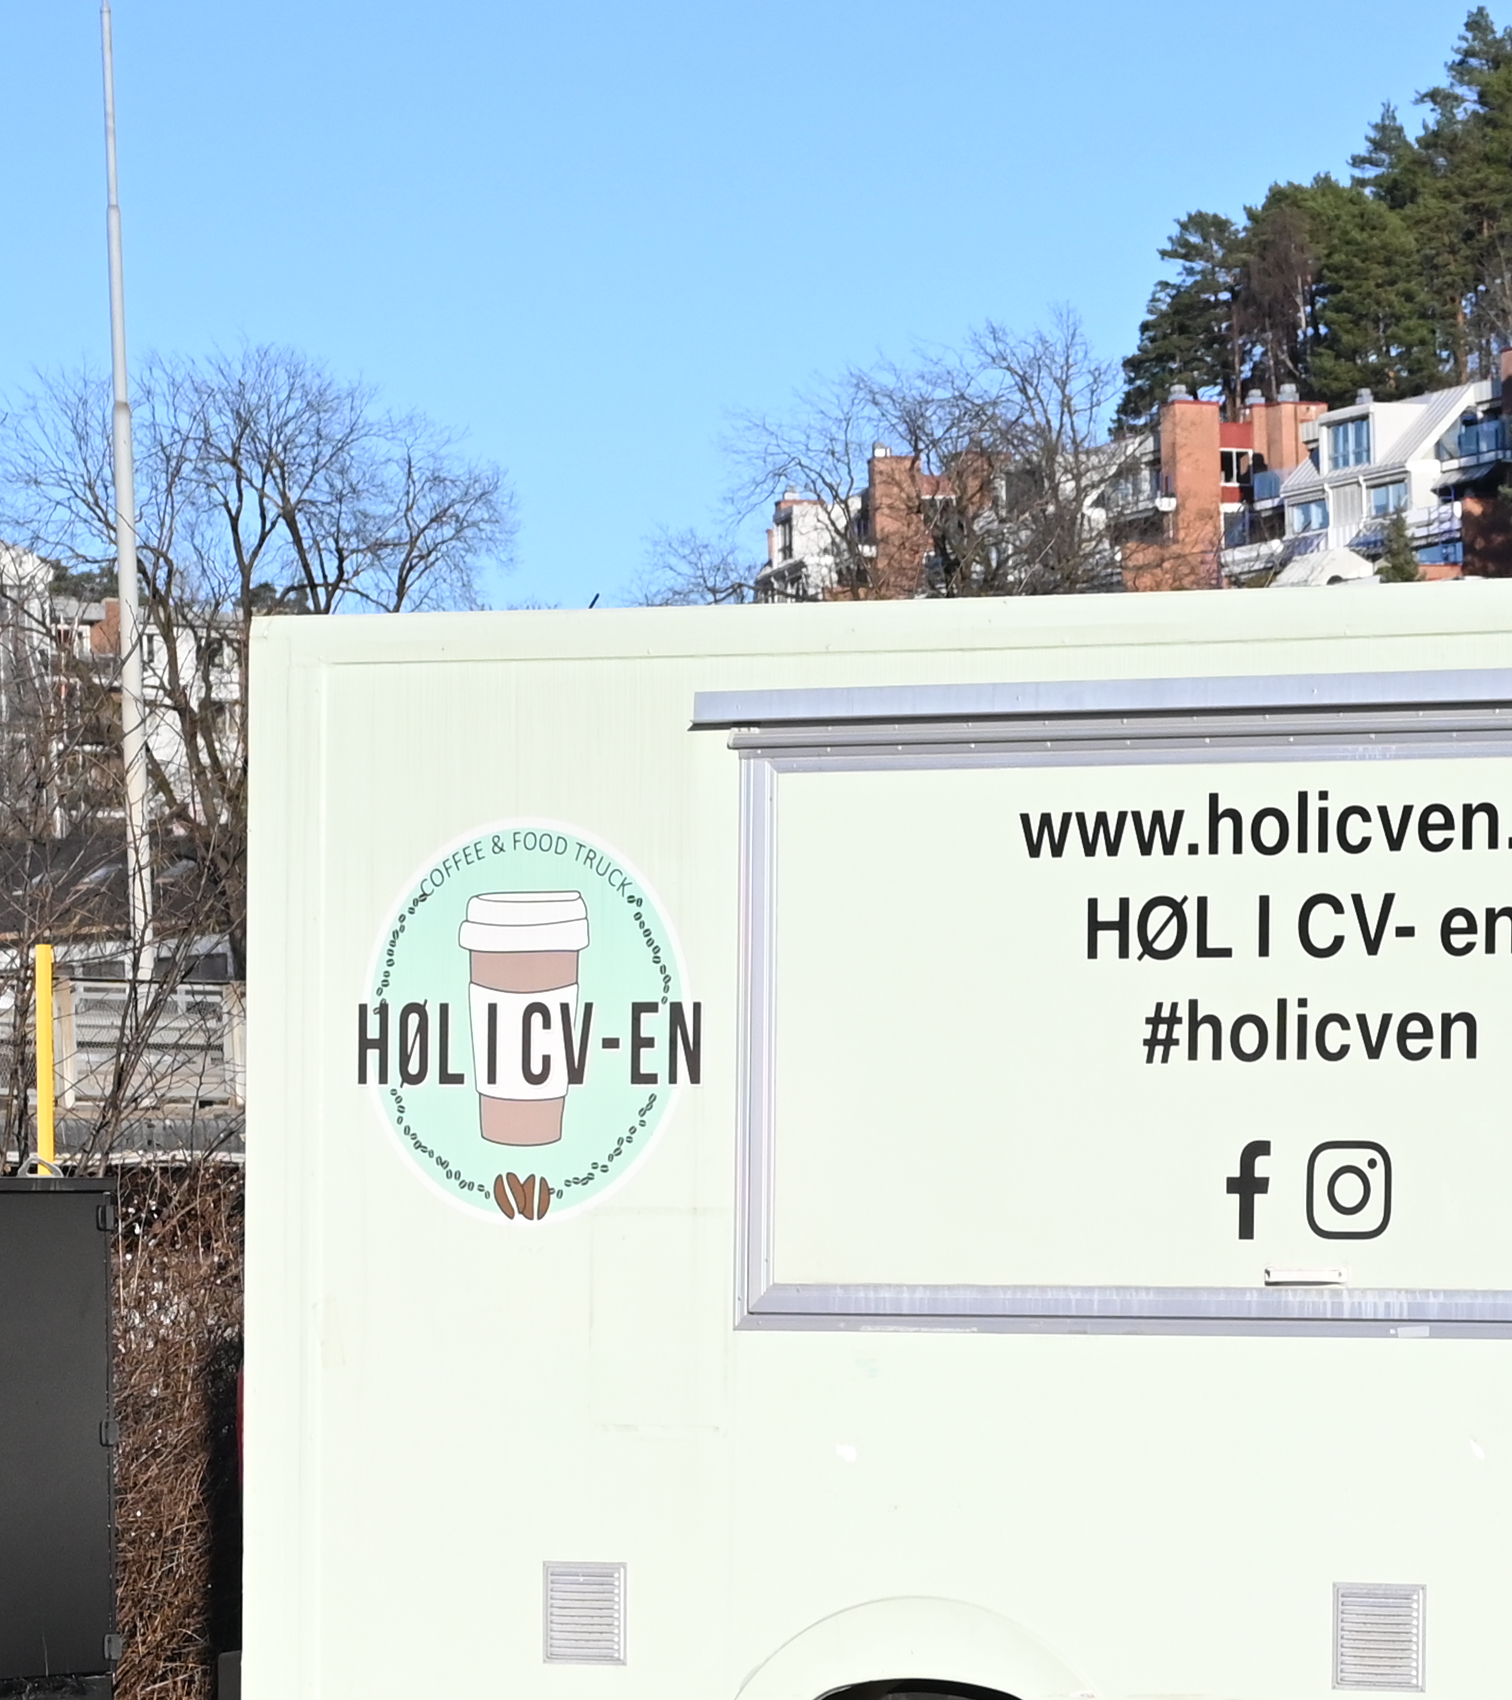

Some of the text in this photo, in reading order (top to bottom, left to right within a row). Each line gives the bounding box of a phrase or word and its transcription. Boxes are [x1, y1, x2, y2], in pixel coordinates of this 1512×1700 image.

[419, 831, 634, 898] COFFEE & FOOD TRUCK
[1087, 894, 1233, 962] HØL
[357, 998, 465, 1089] HØL
[520, 1001, 702, 1086] CV-EN
[1142, 997, 1477, 1064] #holicven
